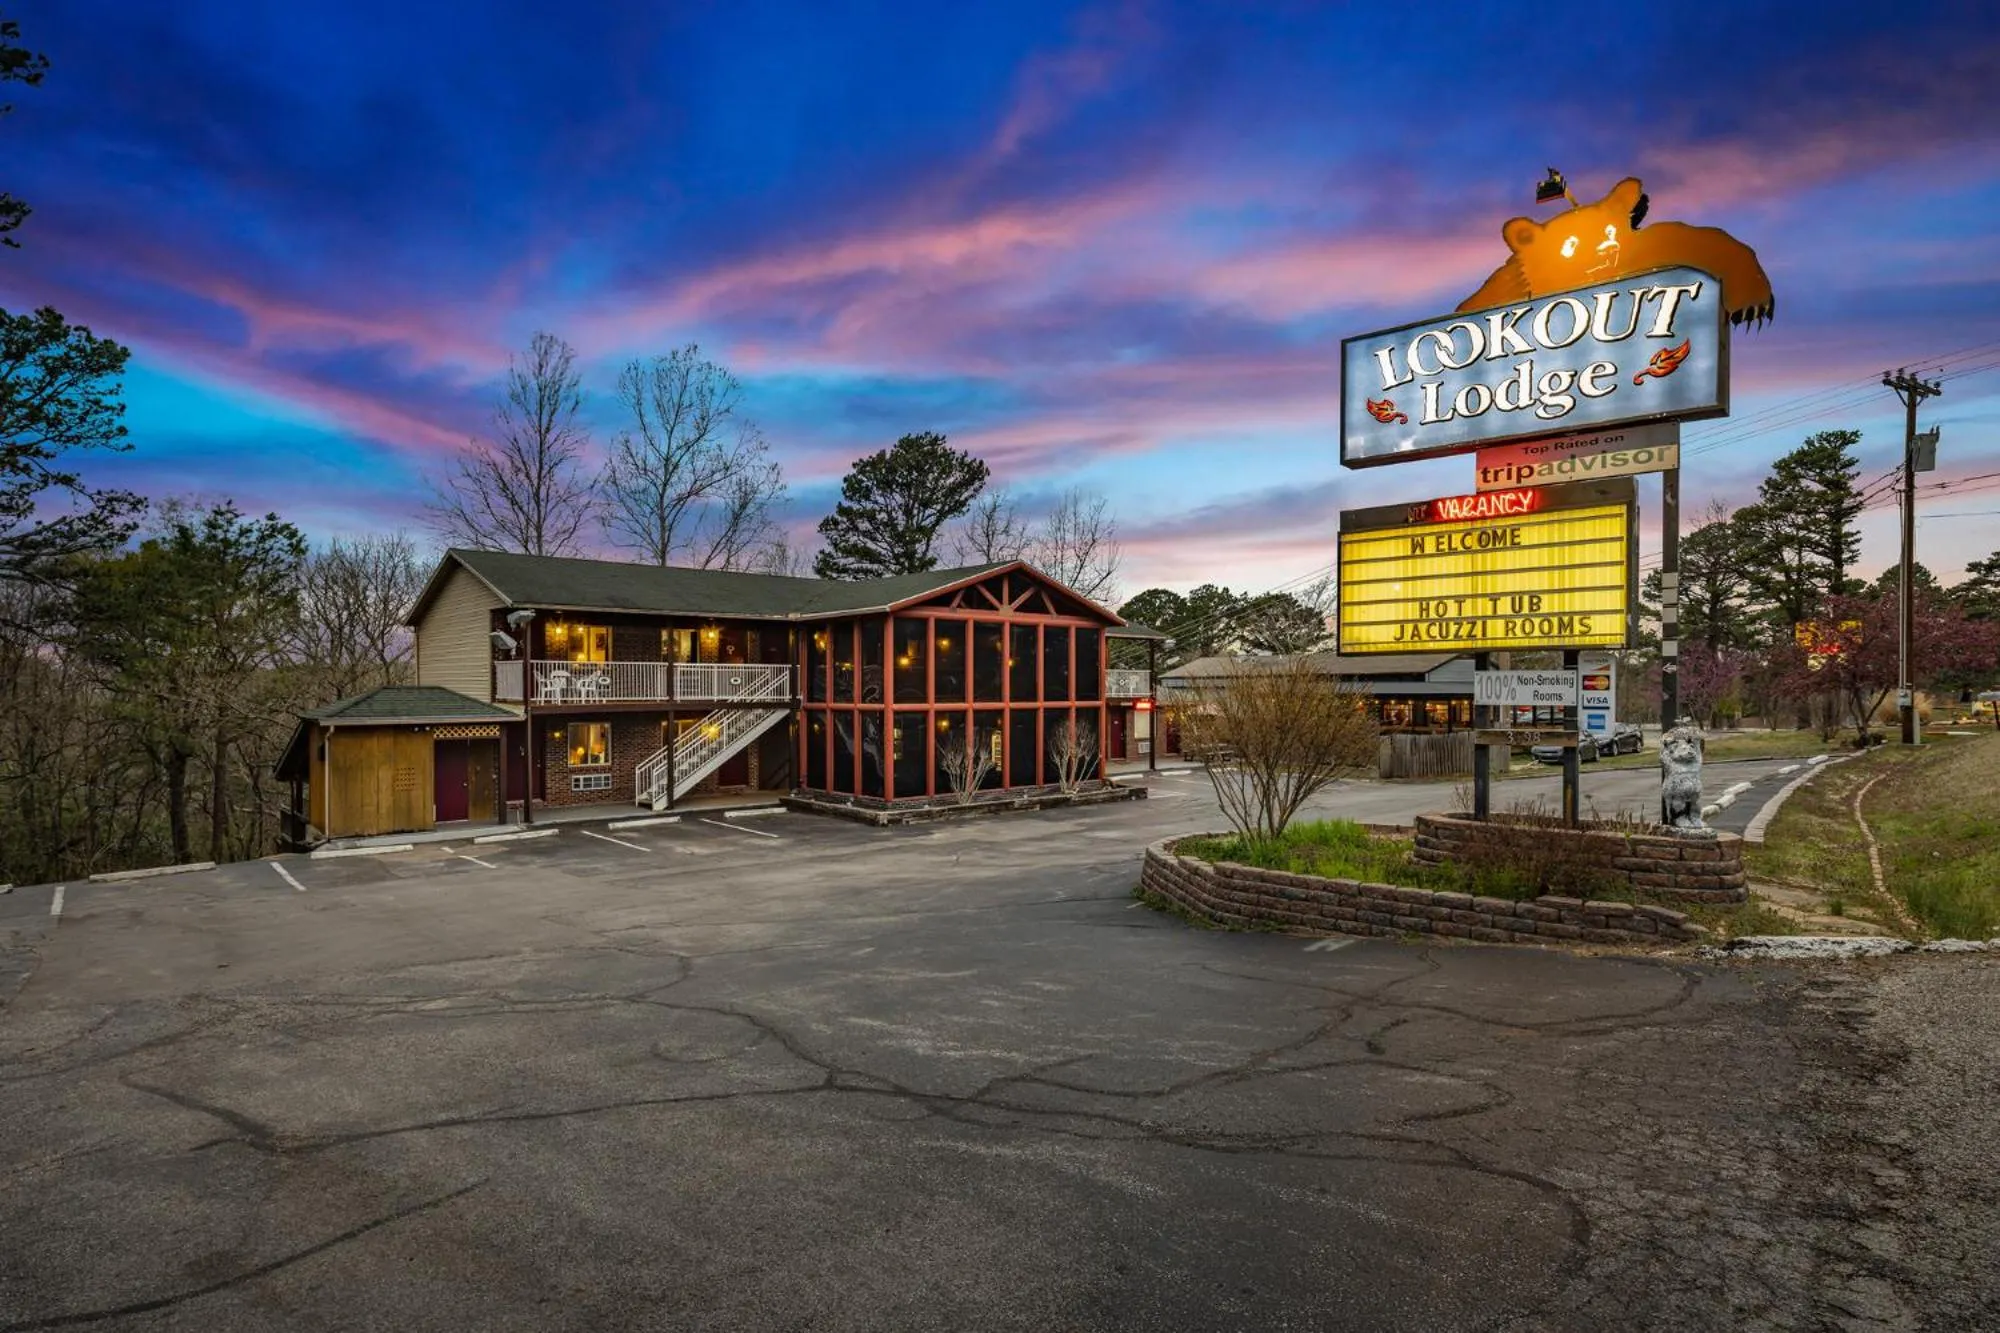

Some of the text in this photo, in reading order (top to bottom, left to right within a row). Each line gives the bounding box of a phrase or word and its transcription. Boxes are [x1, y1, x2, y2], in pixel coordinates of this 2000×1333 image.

[1374, 281, 1702, 390] LOOKOUT
[1420, 360, 1617, 425] Lodge
[1523, 434, 1625, 456] Top Rated on
[1480, 447, 1672, 484] tripadvisor
[1438, 491, 1533, 520] VACANCY
[1410, 527, 1521, 554] WELCOME
[1419, 595, 1542, 618] HOT TUB
[1394, 616, 1592, 641] JACUZZI ROOMS
[1477, 675, 1574, 701] 100% Non-Smoking
[1533, 690, 1563, 702] Rooms
[1586, 696, 1608, 704] VISA
